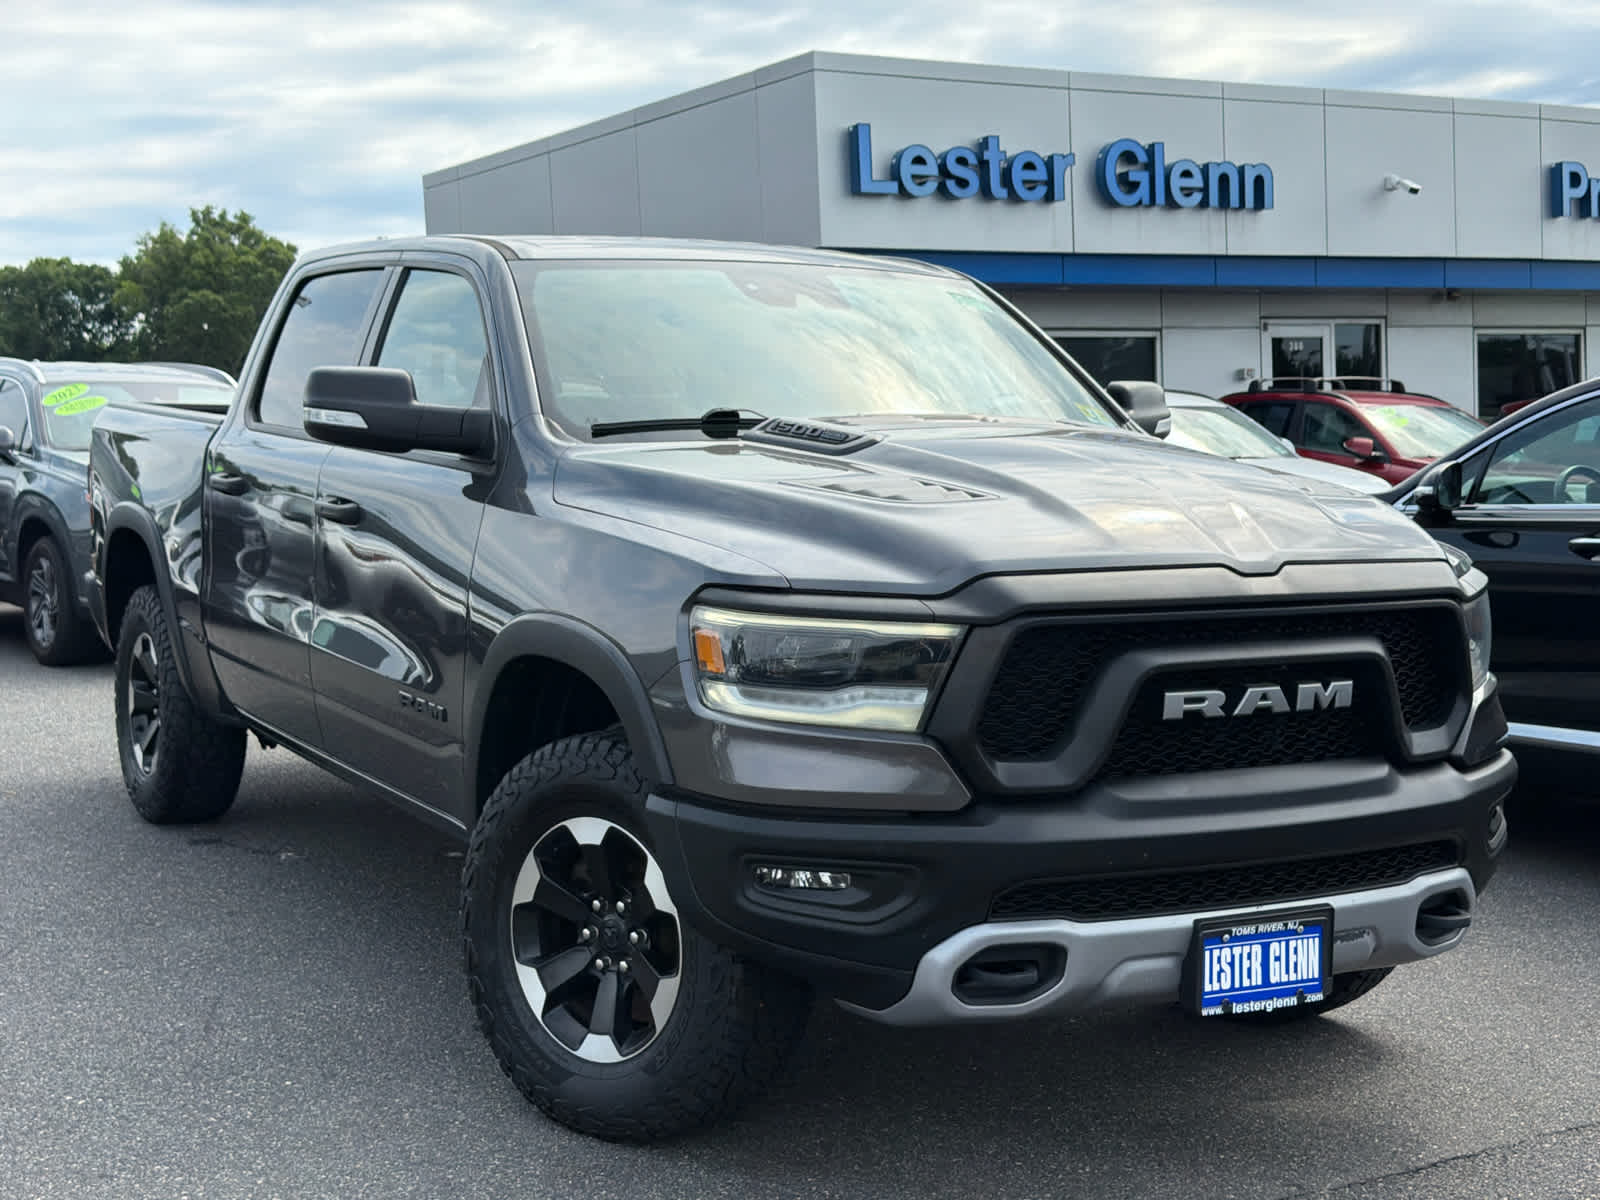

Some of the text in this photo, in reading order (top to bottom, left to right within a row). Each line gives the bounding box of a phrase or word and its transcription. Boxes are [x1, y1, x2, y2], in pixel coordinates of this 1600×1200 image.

[848, 123, 1275, 209] Lester Glenn
[766, 420, 822, 437] 1500
[399, 690, 448, 722] RAM
[1163, 680, 1353, 720] RAM
[1232, 926, 1256, 936] TOMS
[1287, 920, 1299, 930] NJ
[1204, 937, 1319, 992] LESTER GLENN
